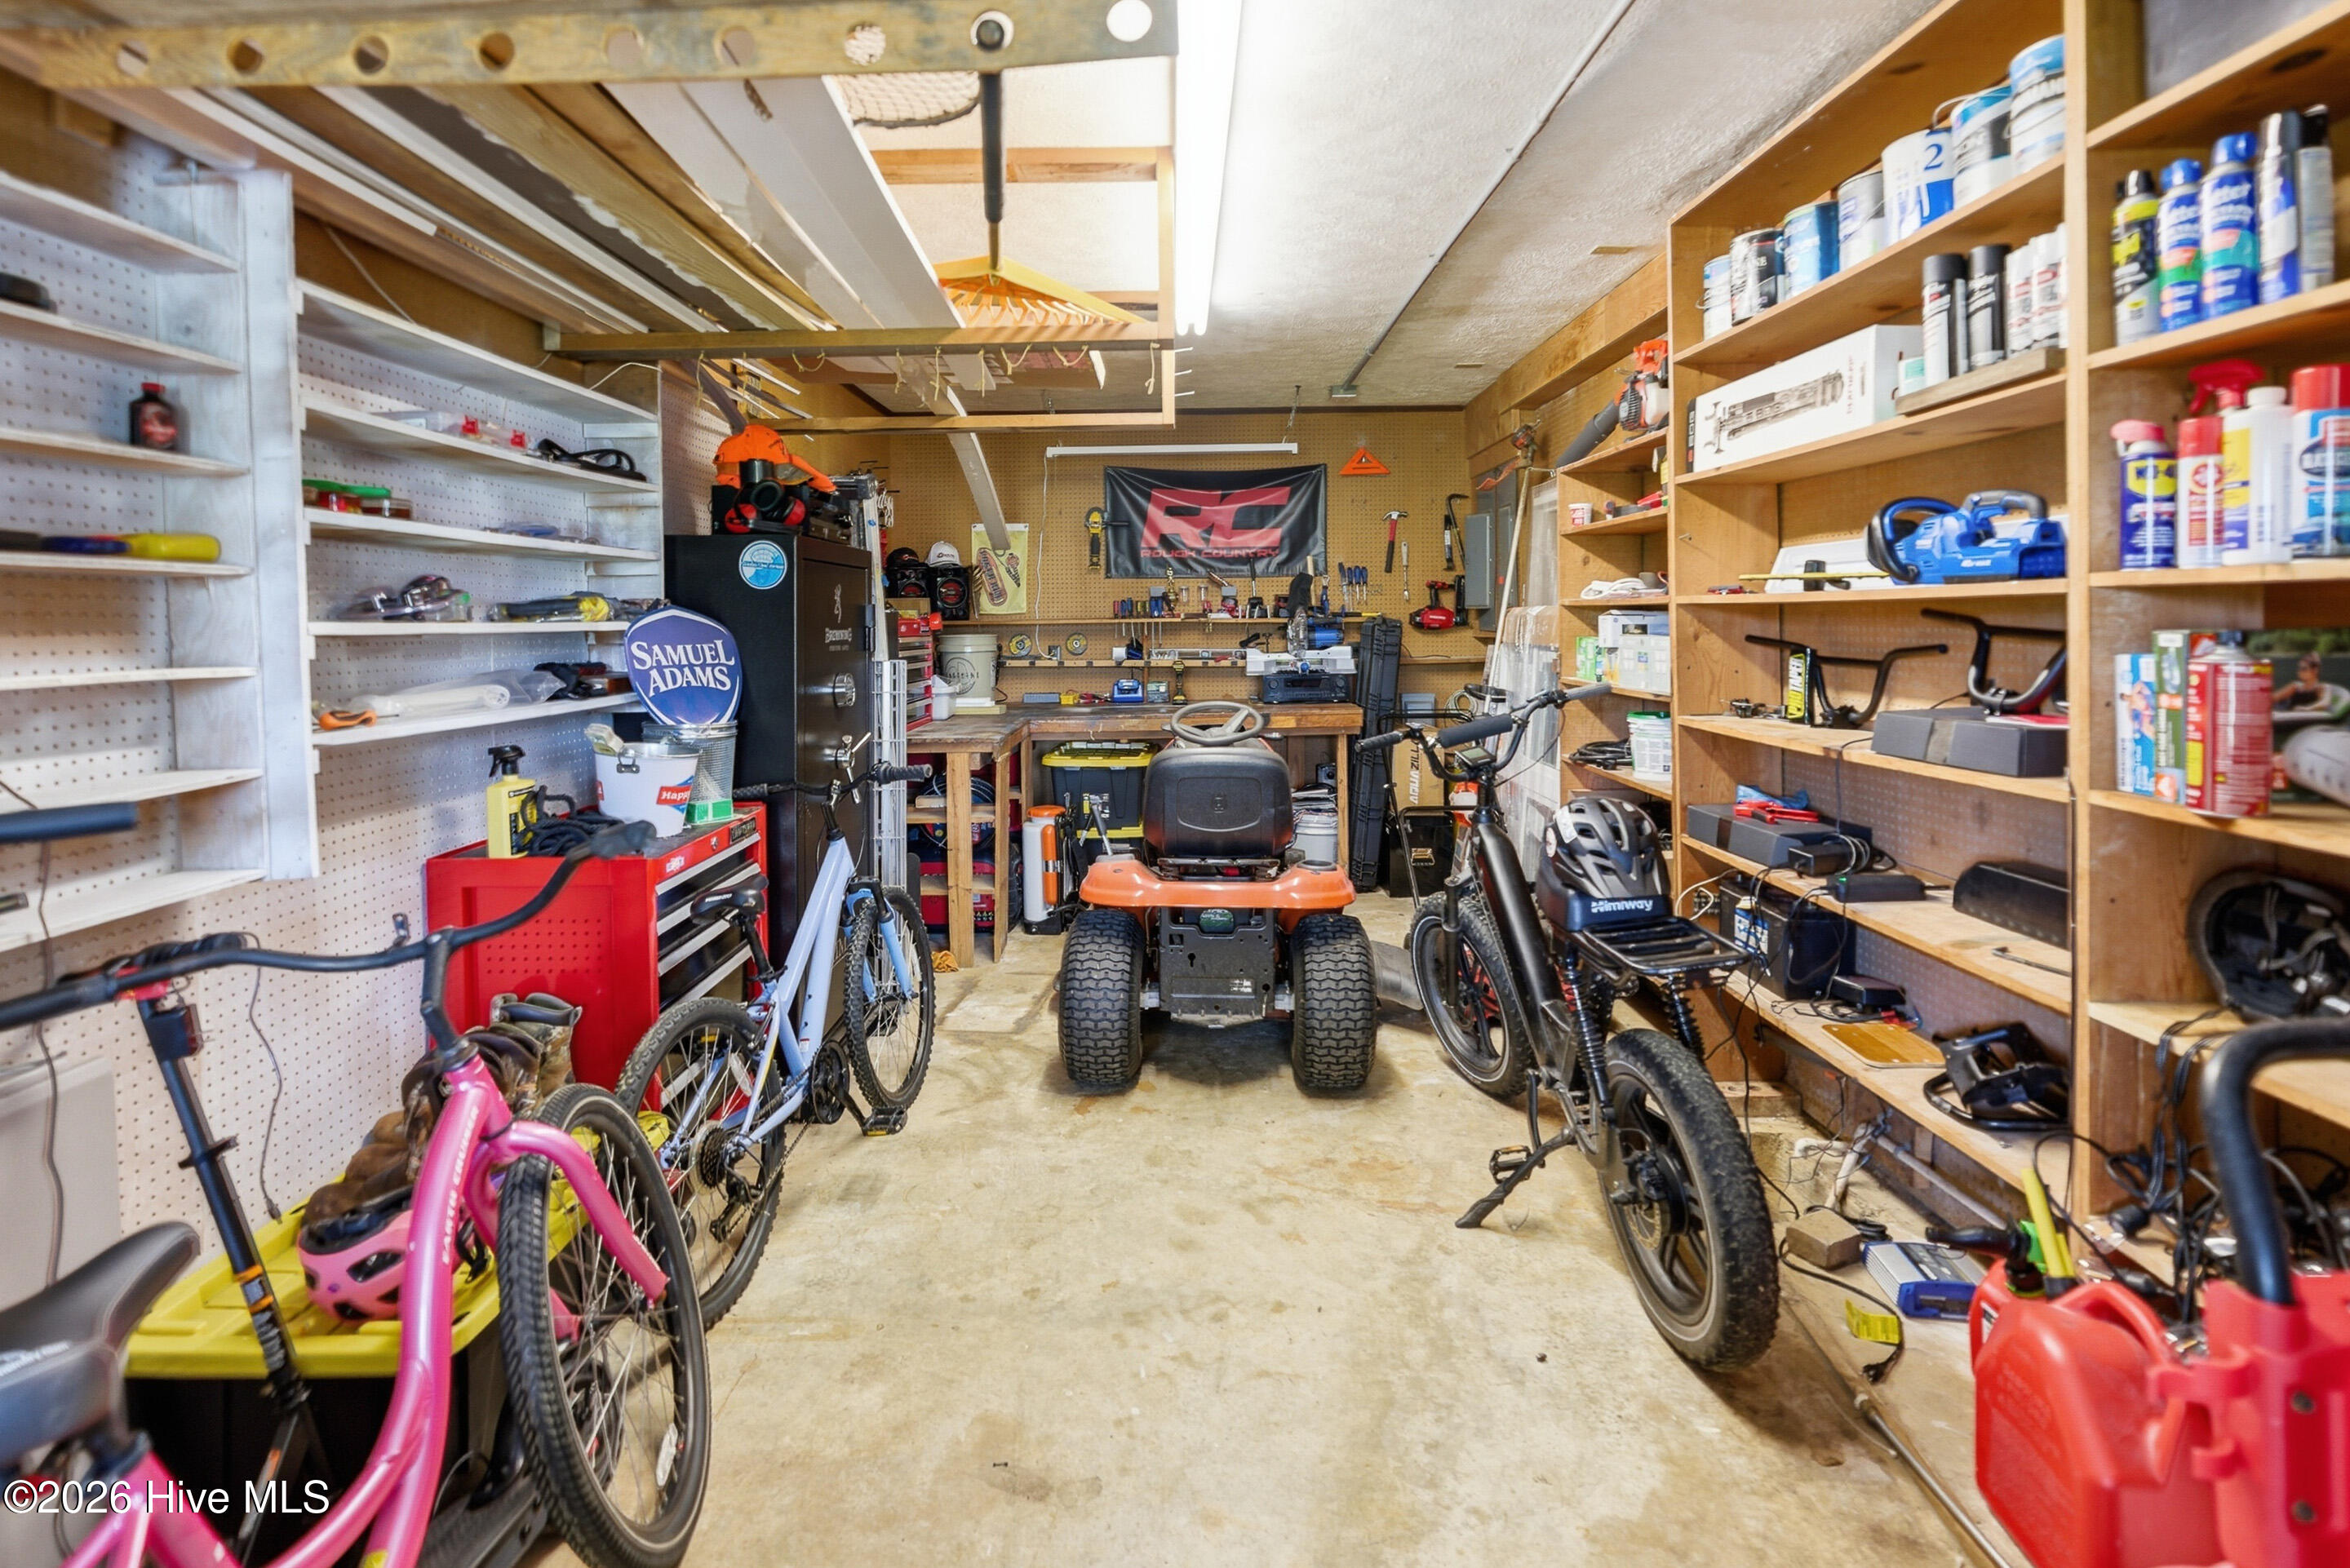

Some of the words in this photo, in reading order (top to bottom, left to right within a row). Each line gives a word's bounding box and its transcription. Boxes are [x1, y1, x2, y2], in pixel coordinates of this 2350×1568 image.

[1923, 143, 1944, 171] 2
[1141, 486, 1292, 547] RC
[1140, 548, 1196, 558] ROUGH
[1200, 548, 1279, 558] COUNTRY
[630, 639, 735, 670] SAMUEL
[649, 666, 732, 698] ADAMS
